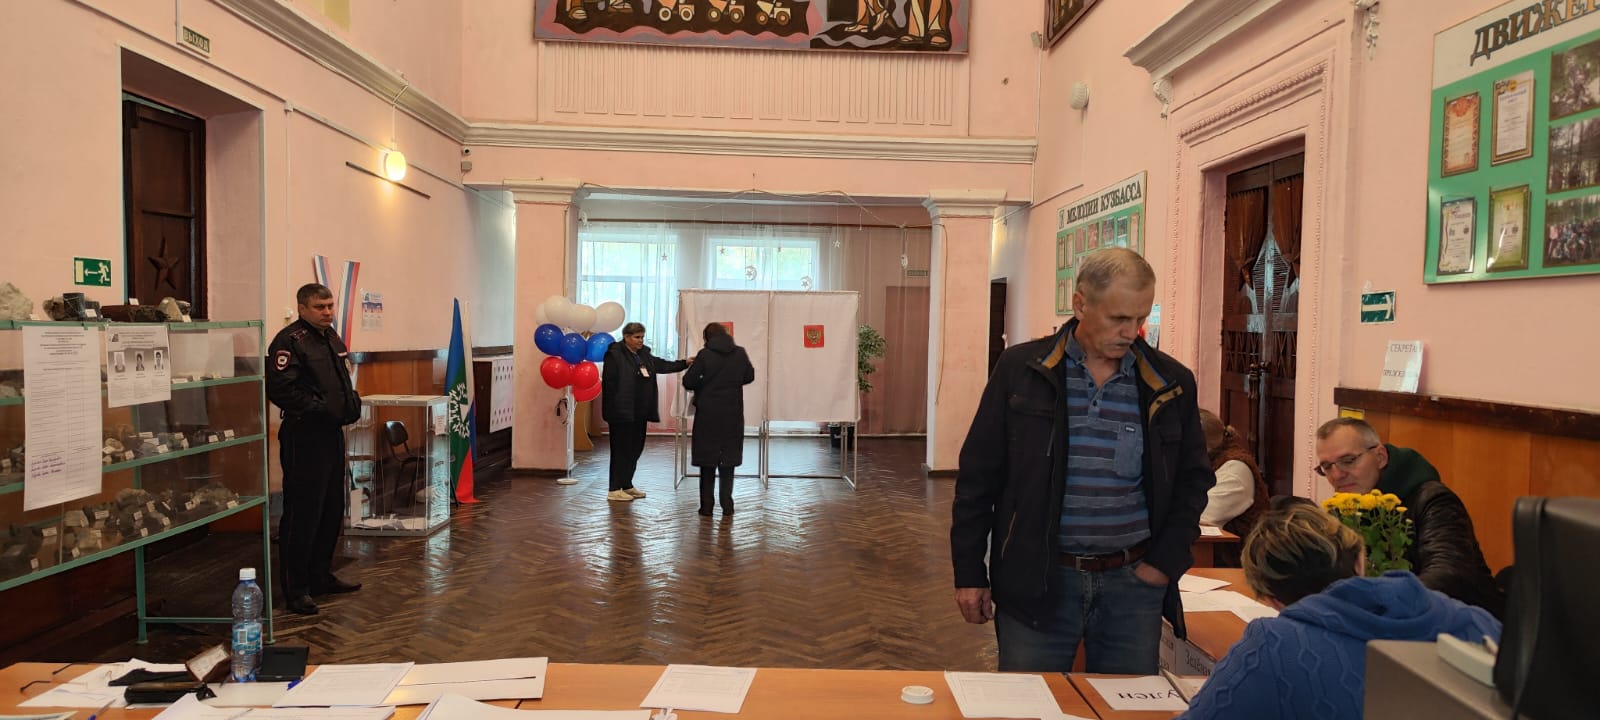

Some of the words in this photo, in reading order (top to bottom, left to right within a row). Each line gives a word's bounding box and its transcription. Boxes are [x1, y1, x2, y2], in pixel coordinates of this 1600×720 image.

[184, 29, 209, 52] ВЫХОД
[1066, 198, 1098, 224] МЕЛОДИИ
[1100, 180, 1142, 212] КУЗБАССА
